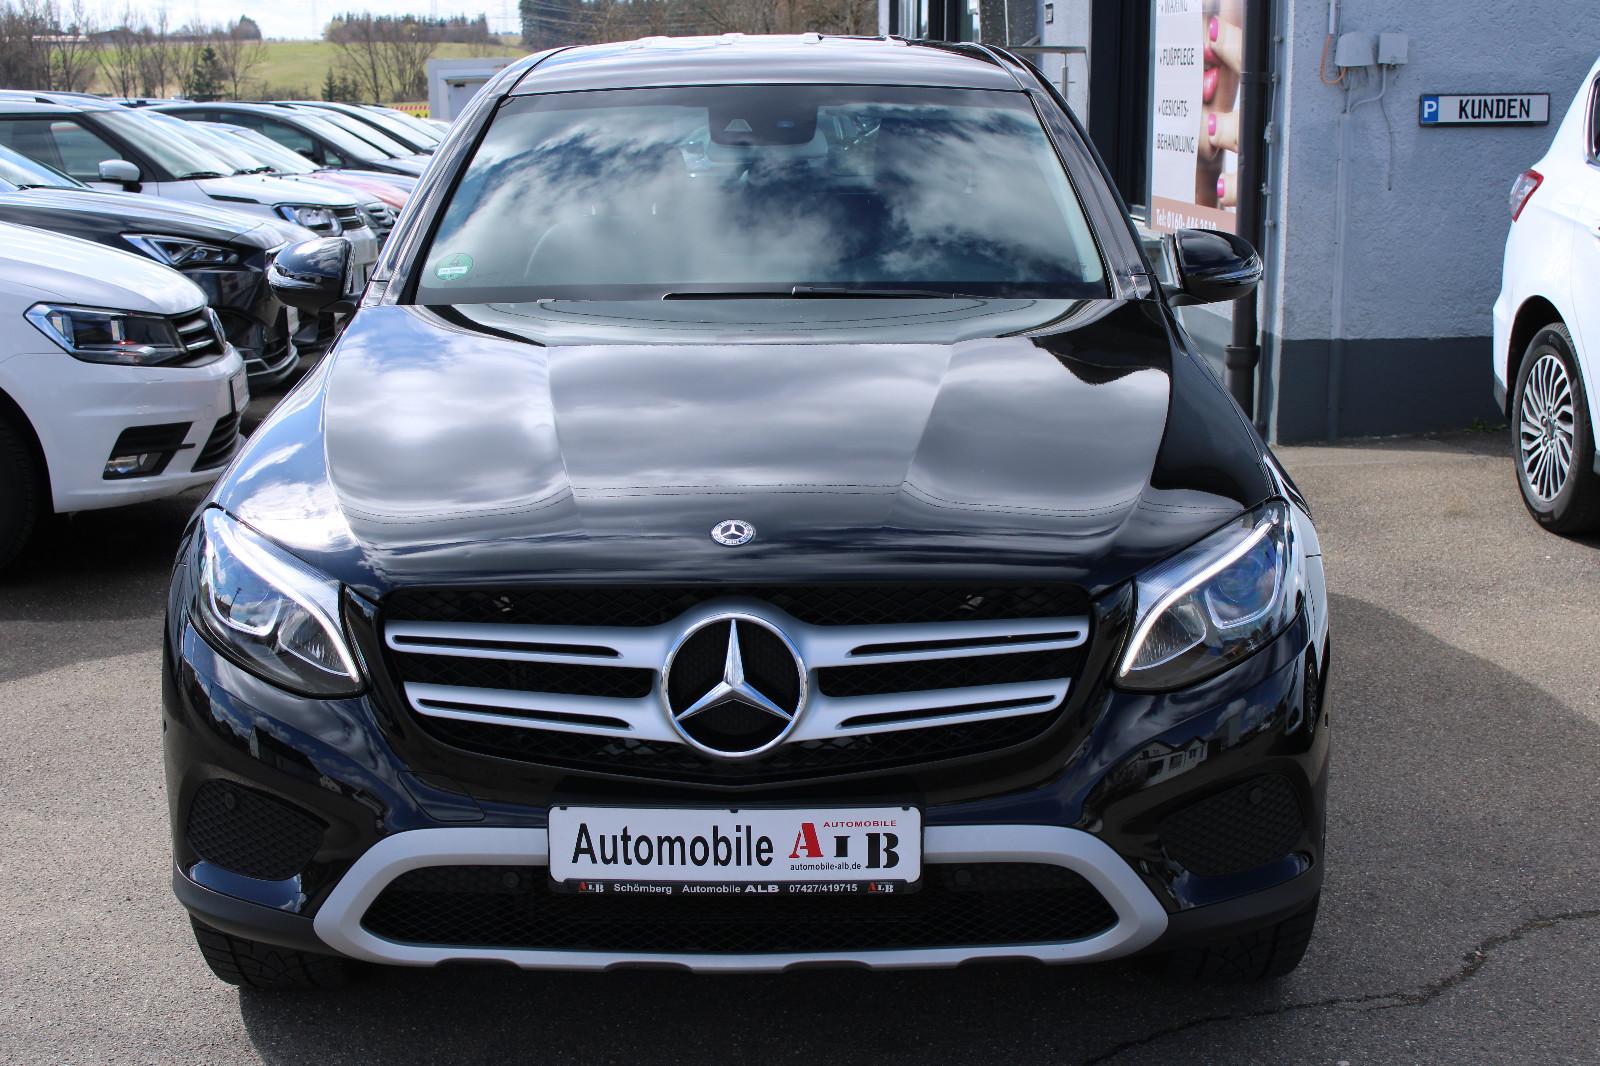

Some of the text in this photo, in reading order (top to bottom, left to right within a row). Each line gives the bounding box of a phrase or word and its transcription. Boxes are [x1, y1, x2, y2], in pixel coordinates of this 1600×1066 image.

[1162, 99, 1189, 117] GESICHTS-
[1423, 98, 1530, 119] P KUNDEN
[1157, 132, 1195, 154] BEHANDLUNG
[823, 820, 897, 828] AUTOMOBILE
[572, 823, 774, 866] Automobile
[790, 862, 862, 871] automobile-alb.de
[614, 883, 858, 894] Schömberg Automobile ALB 07427/419715
